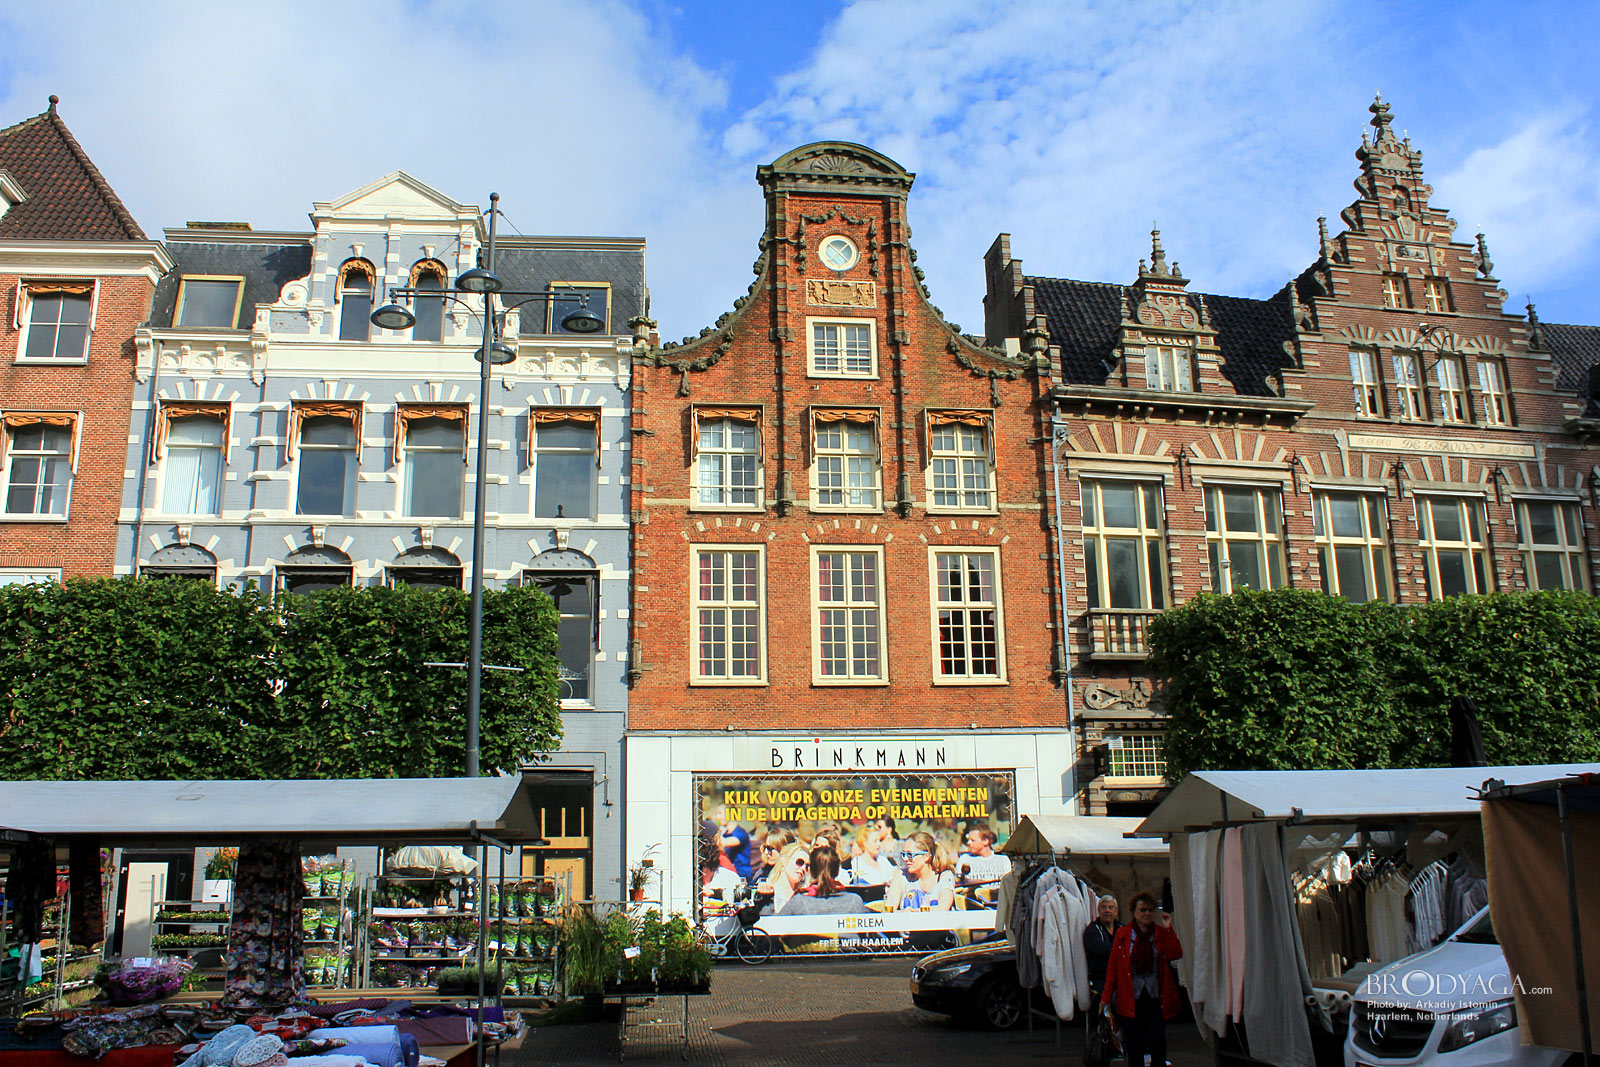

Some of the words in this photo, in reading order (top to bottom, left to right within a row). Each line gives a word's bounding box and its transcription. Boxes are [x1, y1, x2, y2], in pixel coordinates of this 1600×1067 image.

[771, 747, 946, 768] BRINKMANN
[724, 790, 760, 805] KIJK
[766, 790, 814, 805] VOOR
[820, 789, 864, 804] ONZE
[871, 787, 988, 803] EVENEMENTEN
[724, 807, 742, 822] IN
[746, 807, 767, 822] DE
[770, 806, 862, 822] UITAGENDA
[865, 805, 887, 820] OP
[890, 803, 990, 819] HAARLEM.NL
[819, 938, 840, 948] FREE
[841, 938, 860, 947] WIFI
[862, 937, 904, 947] HAARLEM
